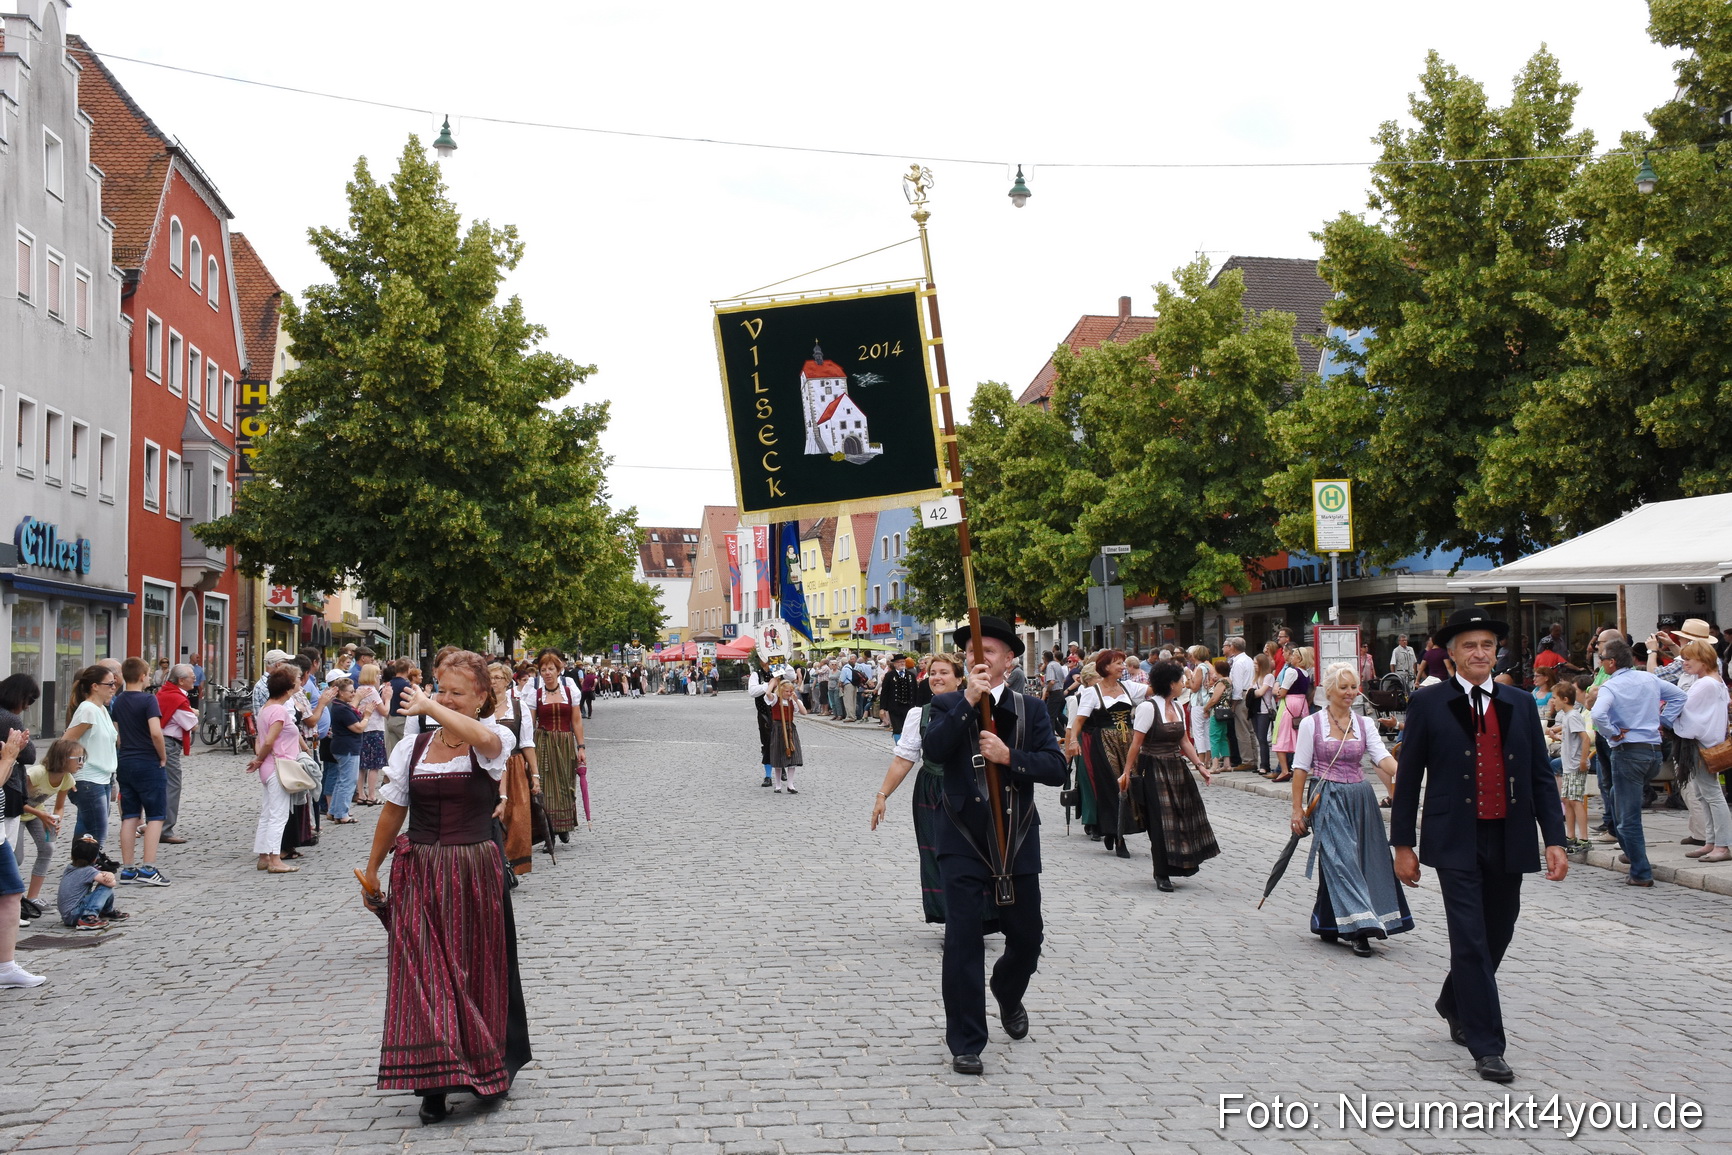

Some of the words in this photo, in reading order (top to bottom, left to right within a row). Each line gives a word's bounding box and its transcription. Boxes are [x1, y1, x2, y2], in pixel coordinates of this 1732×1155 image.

[858, 340, 904, 361] 2014
[740, 317, 786, 499] VILSECK
[929, 506, 948, 520] 42
[17, 515, 78, 571] Eilles
[1260, 564, 1314, 590] ANTON
